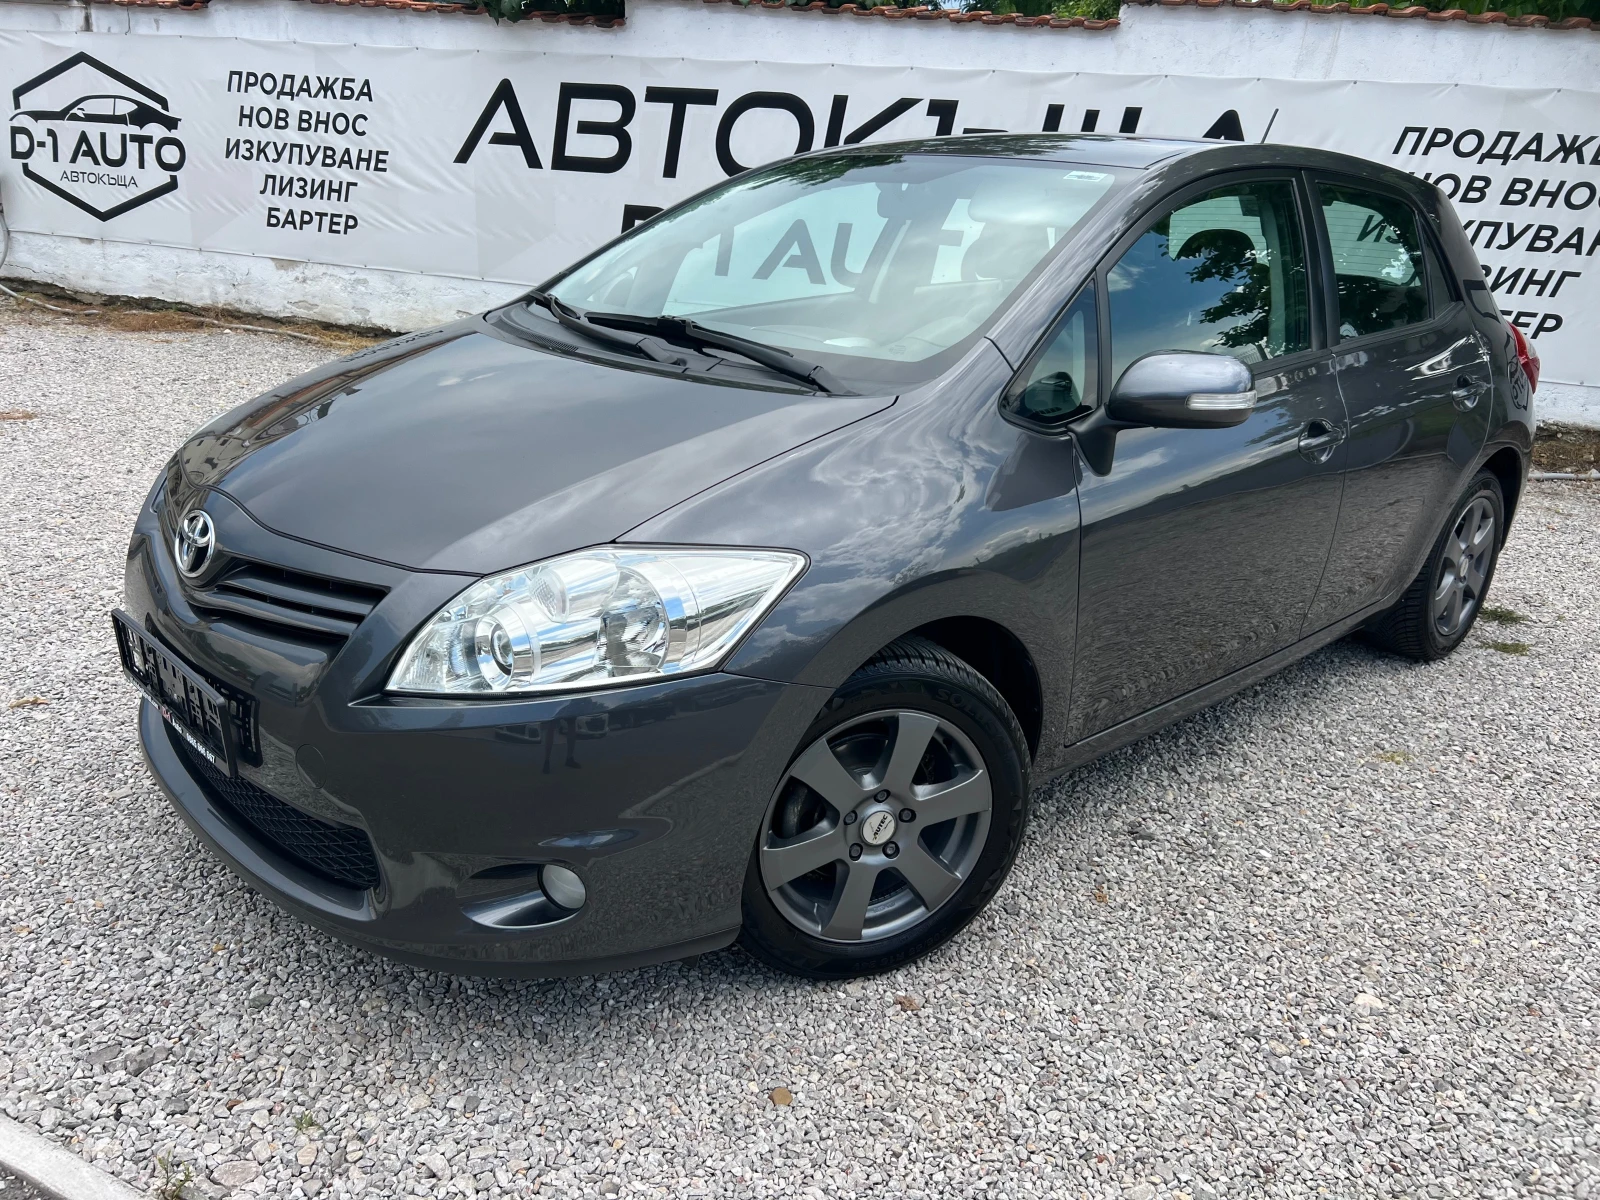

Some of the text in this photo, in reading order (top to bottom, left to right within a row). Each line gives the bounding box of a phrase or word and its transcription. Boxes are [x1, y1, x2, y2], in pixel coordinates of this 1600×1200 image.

[227, 70, 373, 102] ПРОДАЖБА
[238, 105, 368, 137] НОВ ВНОС
[11, 125, 186, 172] D-1 AUTO
[225, 138, 389, 173] ИЗКУПУВАНЕ
[60, 169, 138, 189] АВТОКЪЩА
[260, 174, 358, 202] ЛИЗИНГ
[1409, 172, 1600, 211] ОВ ВНО
[266, 207, 358, 235] БАРТЕР
[873, 814, 888, 841] AUTEC
